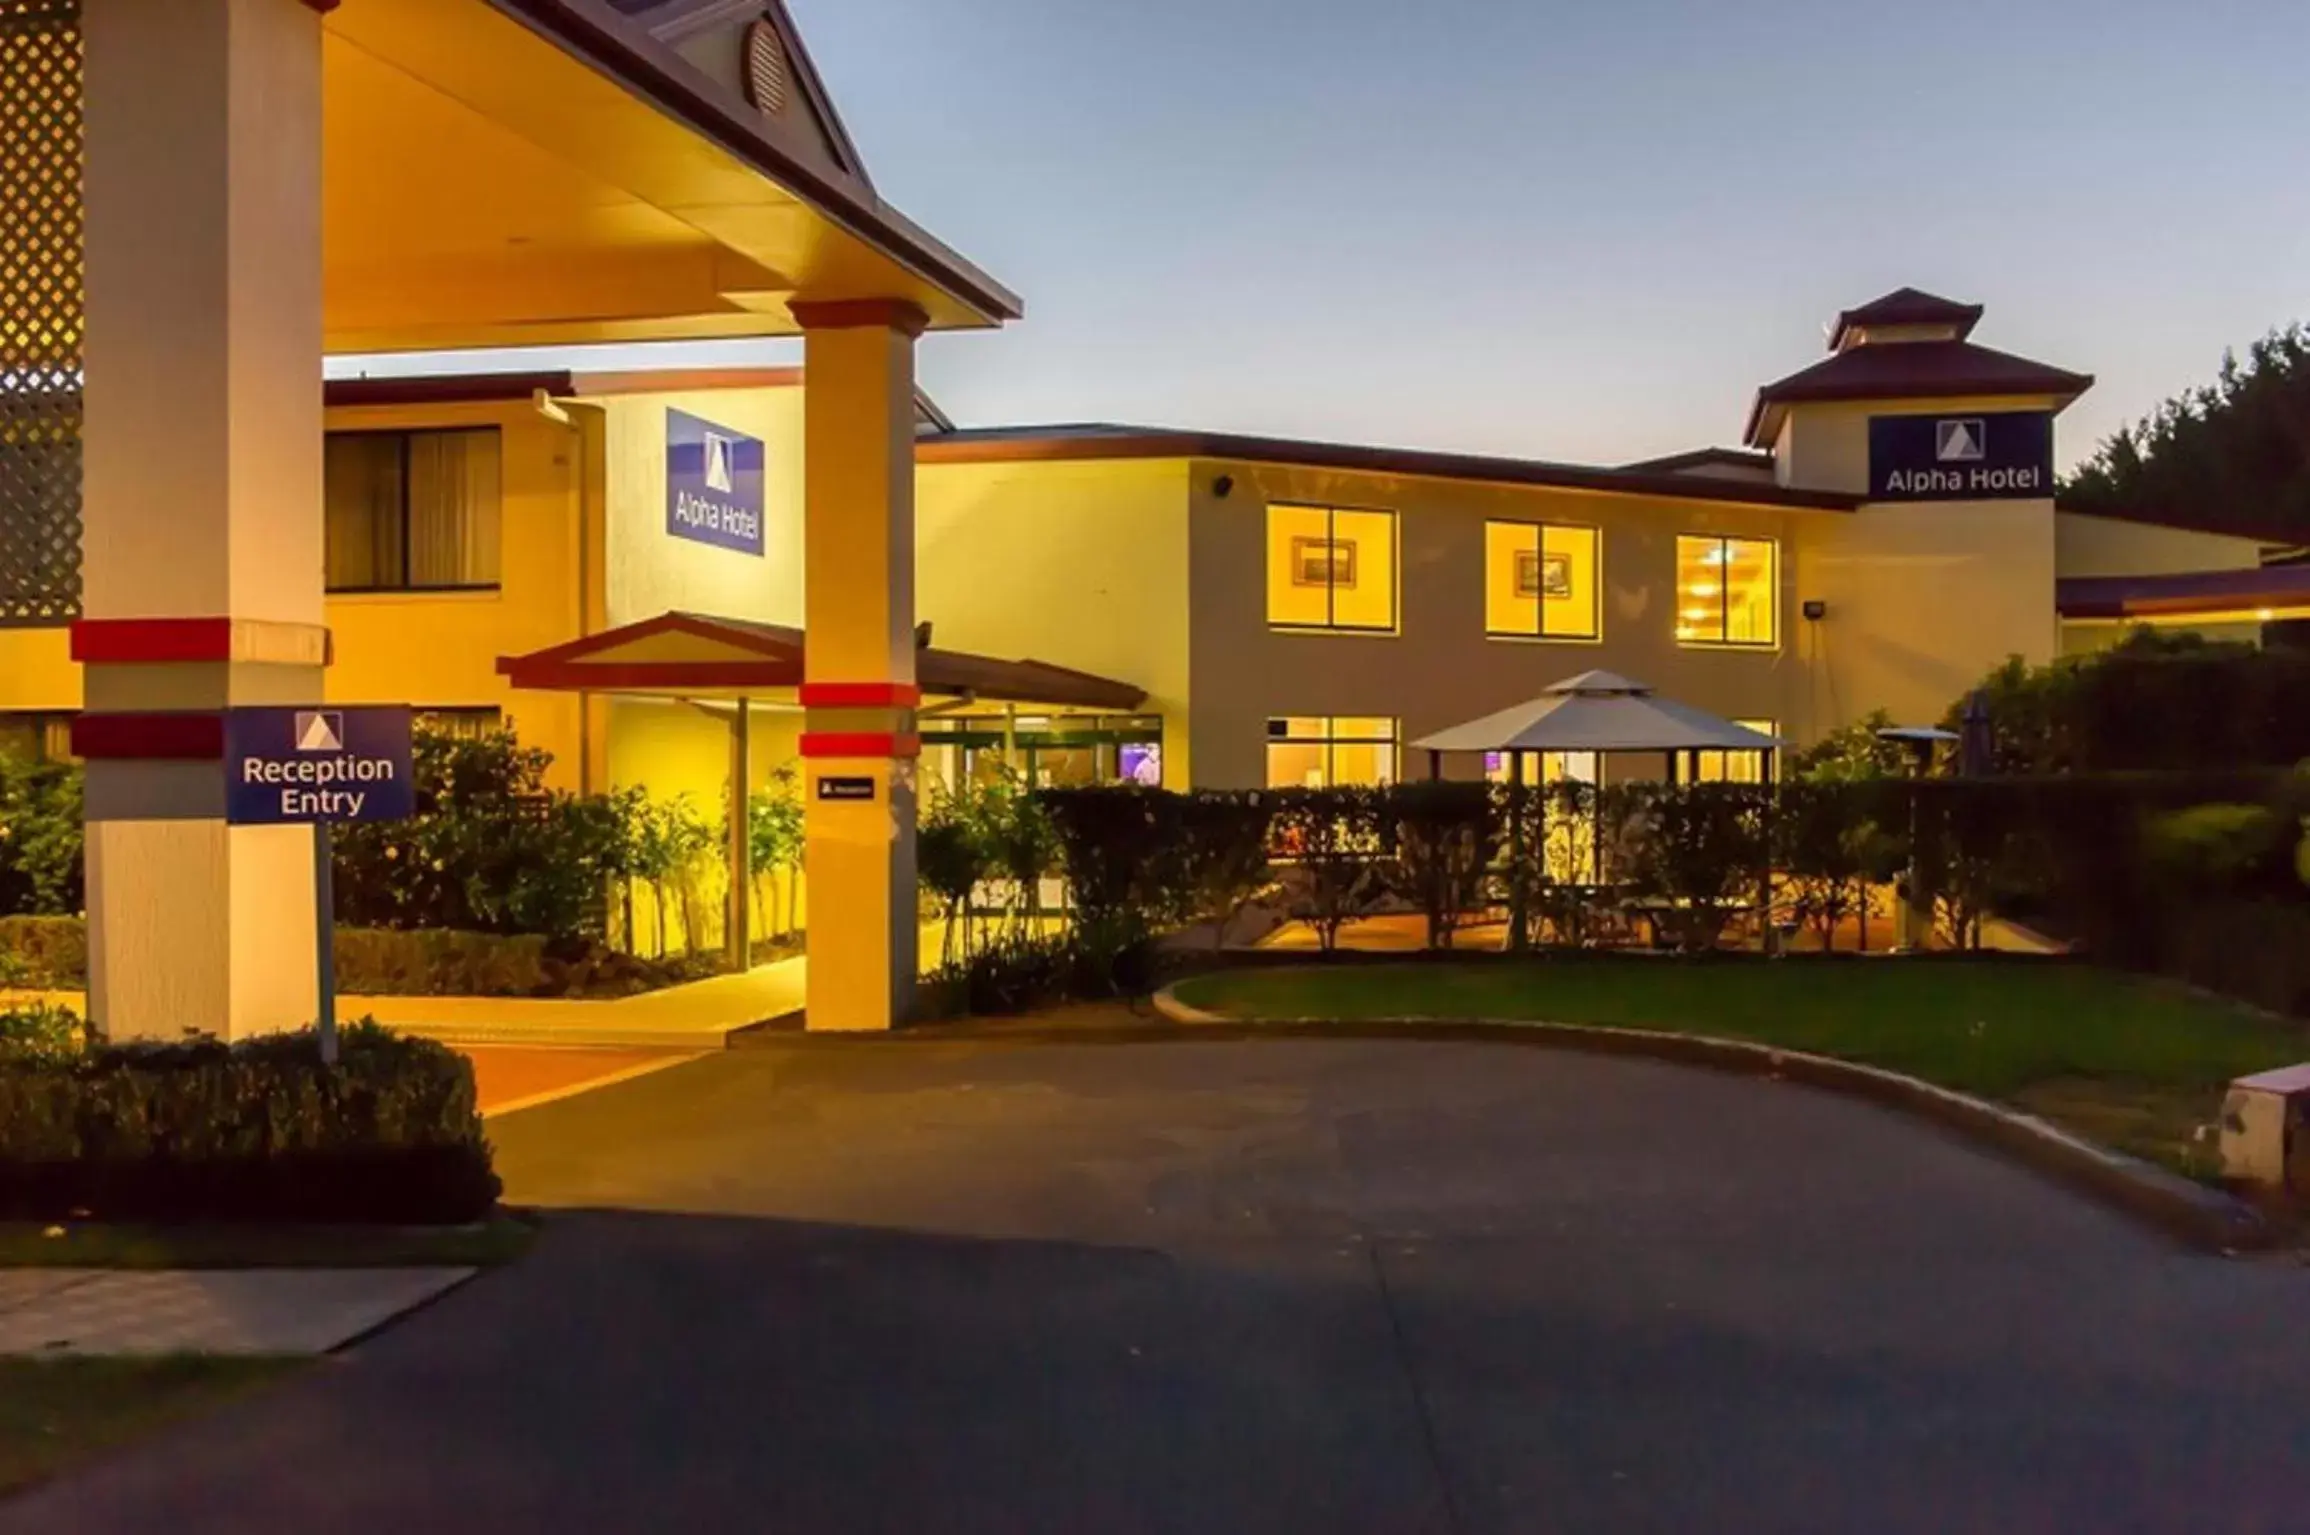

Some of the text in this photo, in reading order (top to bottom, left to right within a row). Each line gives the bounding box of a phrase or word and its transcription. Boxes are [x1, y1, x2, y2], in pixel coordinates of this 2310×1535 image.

[1886, 465, 2039, 492] Alpha Hotel
[676, 489, 758, 539] Alpha Hotel
[243, 754, 394, 785] Reception
[281, 789, 365, 816] Entry
